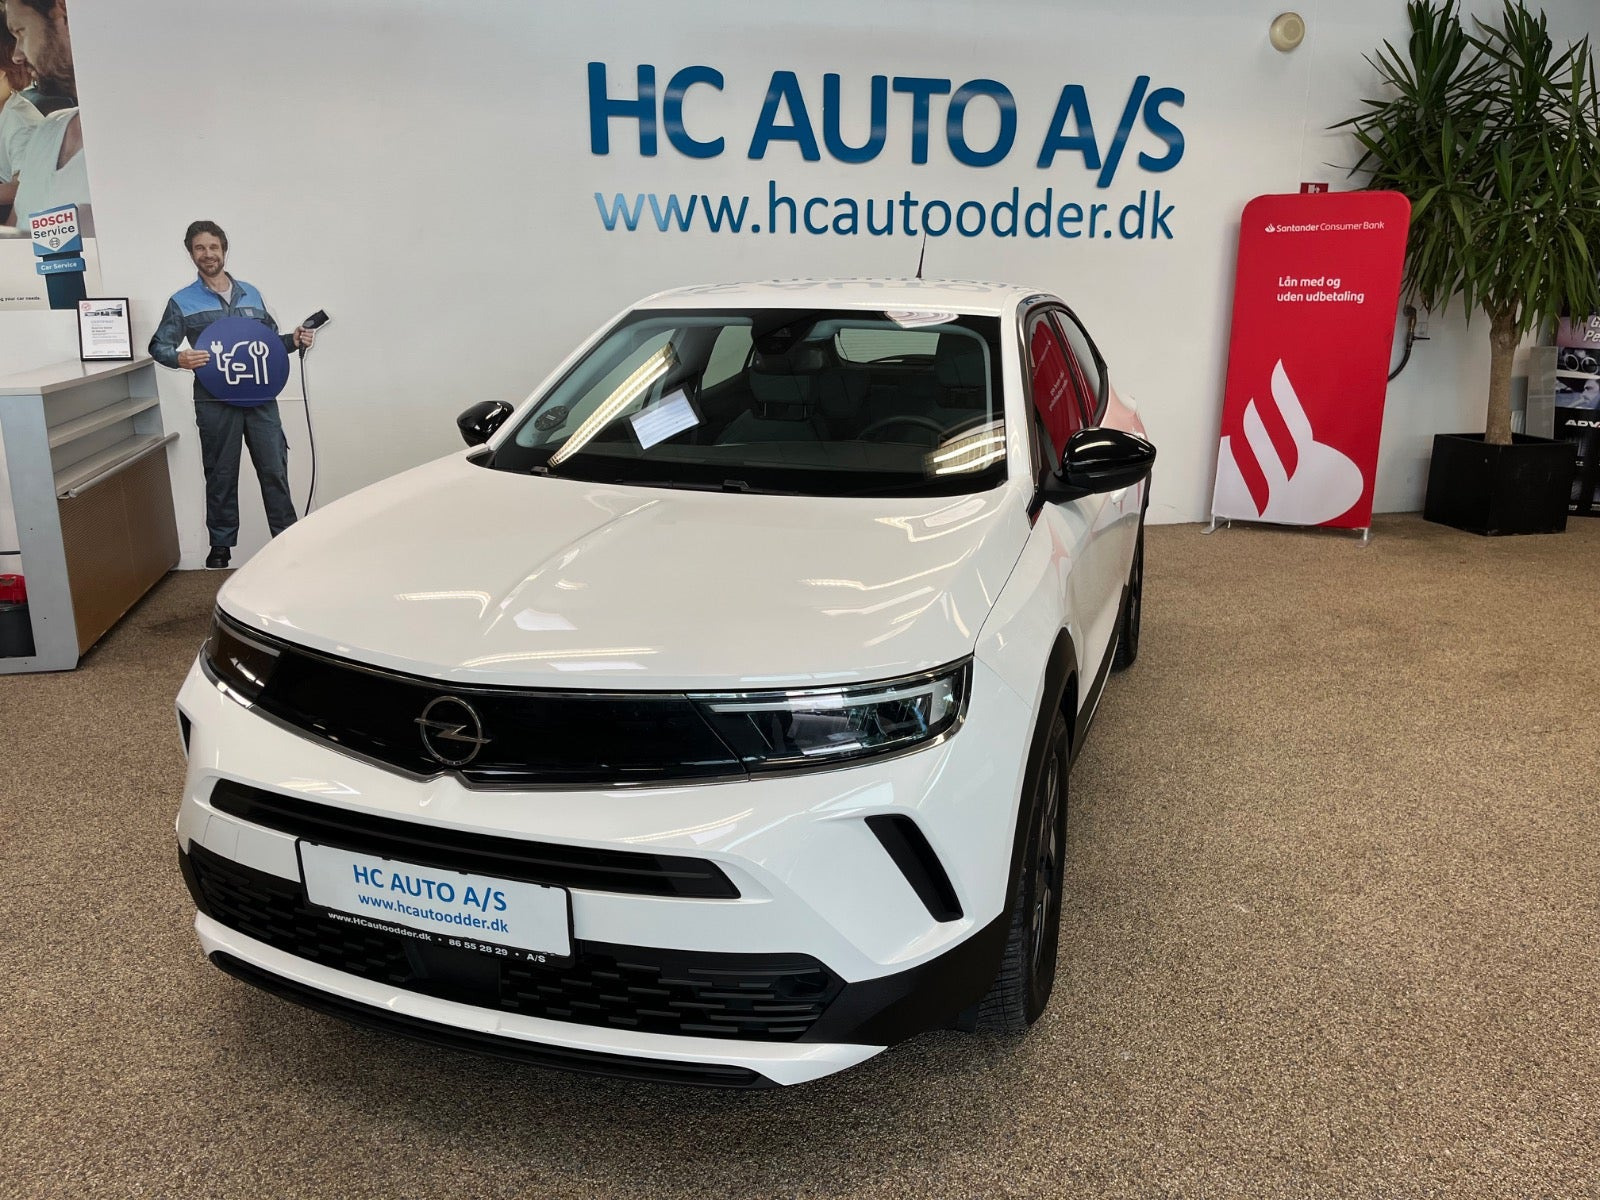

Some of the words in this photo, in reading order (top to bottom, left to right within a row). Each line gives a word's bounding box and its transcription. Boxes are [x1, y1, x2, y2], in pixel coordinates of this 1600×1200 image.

[588, 61, 725, 159] HC
[748, 70, 1017, 168] AUTO
[1037, 75, 1186, 188] A/S
[594, 180, 1176, 240] www.hcautoodder.dk
[32, 212, 73, 229] BOSCH
[1276, 223, 1319, 233] Santander
[1320, 222, 1363, 231] Consumer
[1363, 221, 1385, 230] Bank
[33, 225, 76, 239] Service
[53, 262, 78, 270] Service
[1278, 276, 1298, 287] Lån
[1300, 276, 1324, 287] med
[1326, 278, 1341, 289] og
[1277, 291, 1304, 302] uden
[1306, 291, 1365, 304] udbetaling
[352, 864, 385, 889] HC
[390, 873, 455, 903] AUTO
[463, 886, 507, 912] A/S
[358, 893, 509, 933] www.hcautoodder.dk
[327, 911, 432, 942] www.HCautoodder.dk
[448, 938, 462, 948] 86
[463, 941, 477, 951] 55
[479, 943, 493, 954] 28
[494, 945, 508, 956] 29
[526, 952, 546, 964] A/S
